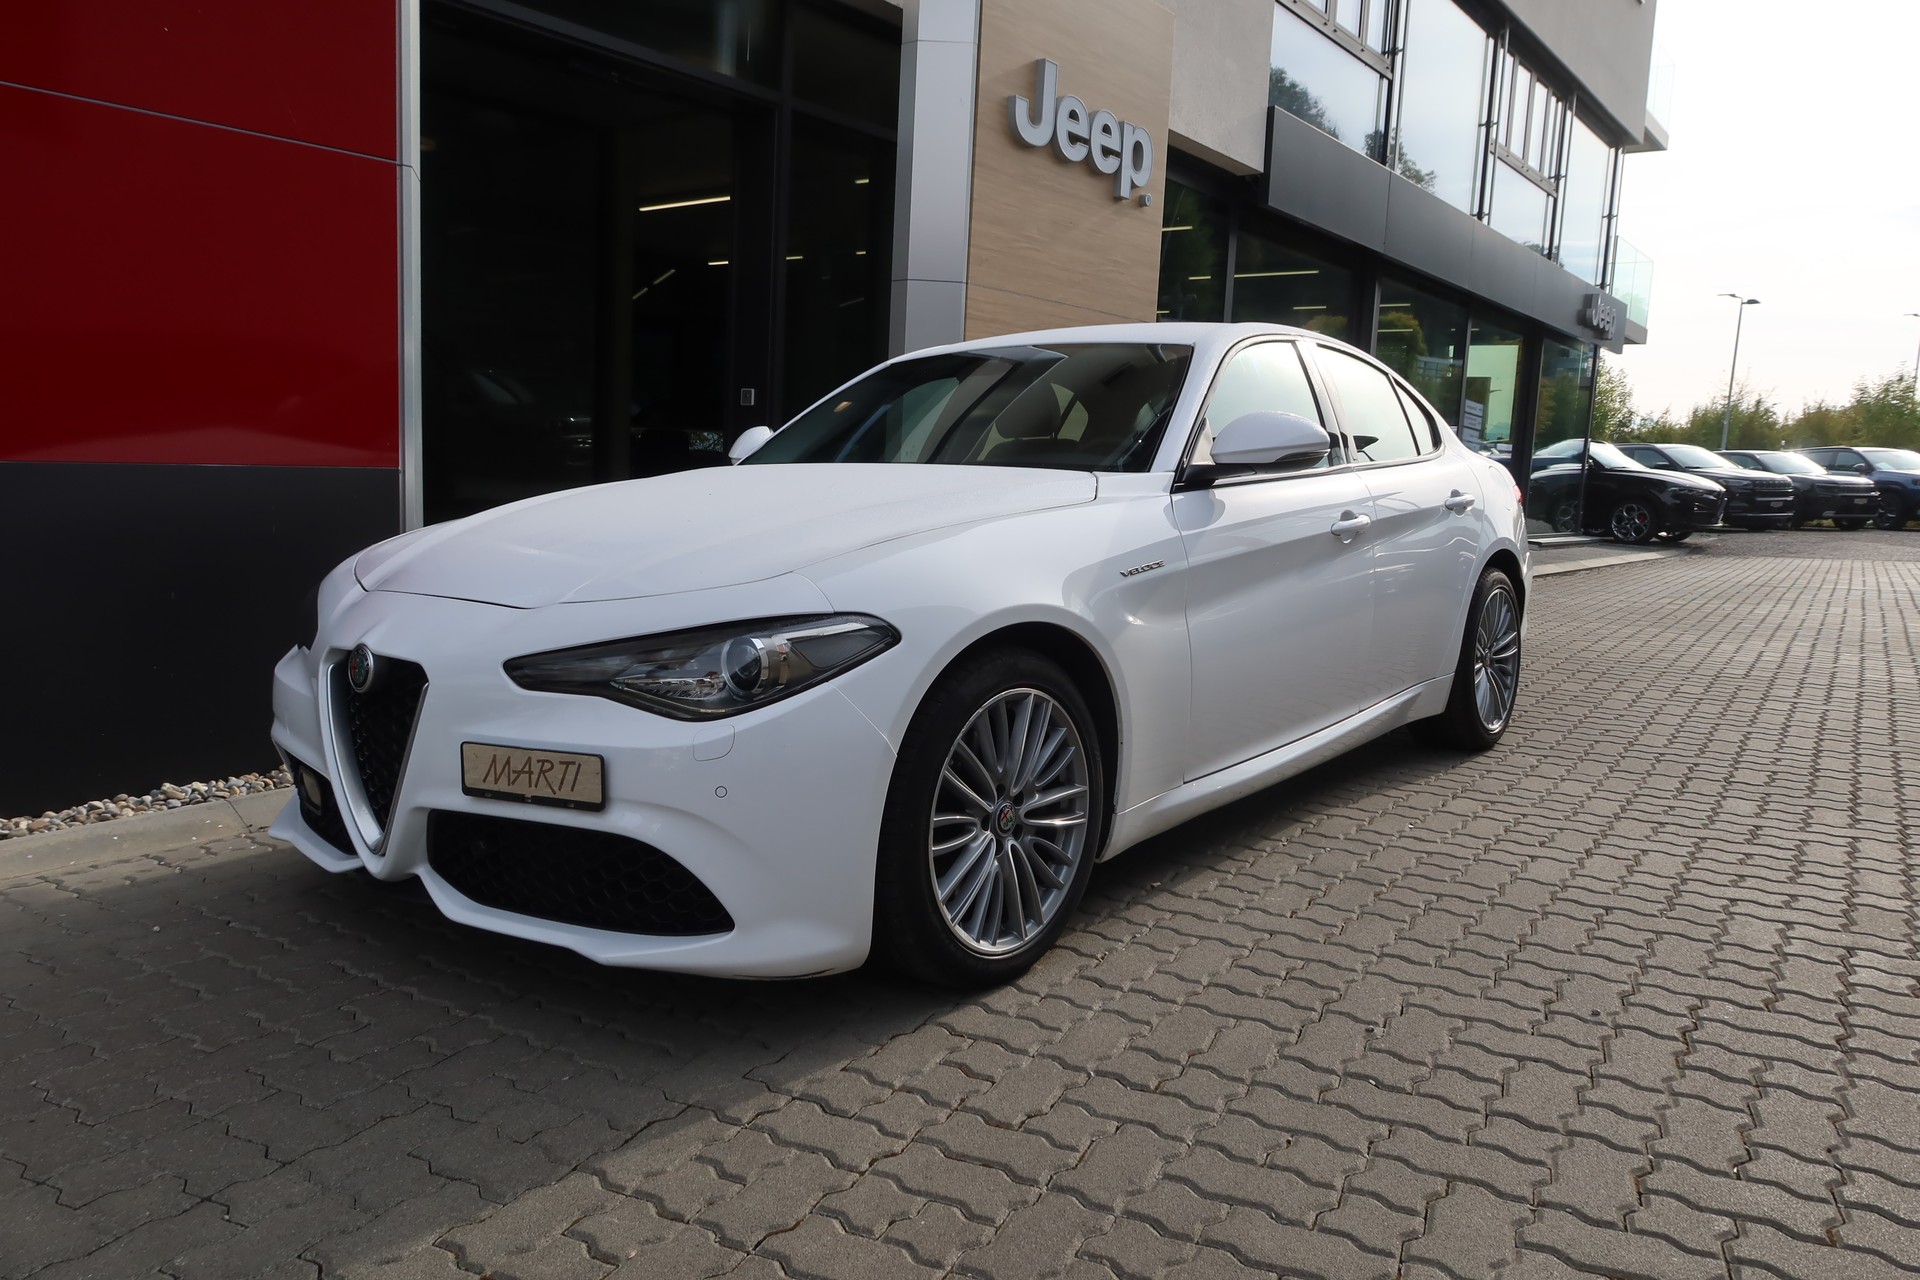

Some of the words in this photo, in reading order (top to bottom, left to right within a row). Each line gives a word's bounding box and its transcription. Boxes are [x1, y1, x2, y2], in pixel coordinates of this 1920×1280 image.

[1008, 58, 1154, 200] Jeep
[1587, 293, 1617, 340] Jeep
[1120, 560, 1165, 577] VELOCE
[482, 754, 582, 795] MARTI
